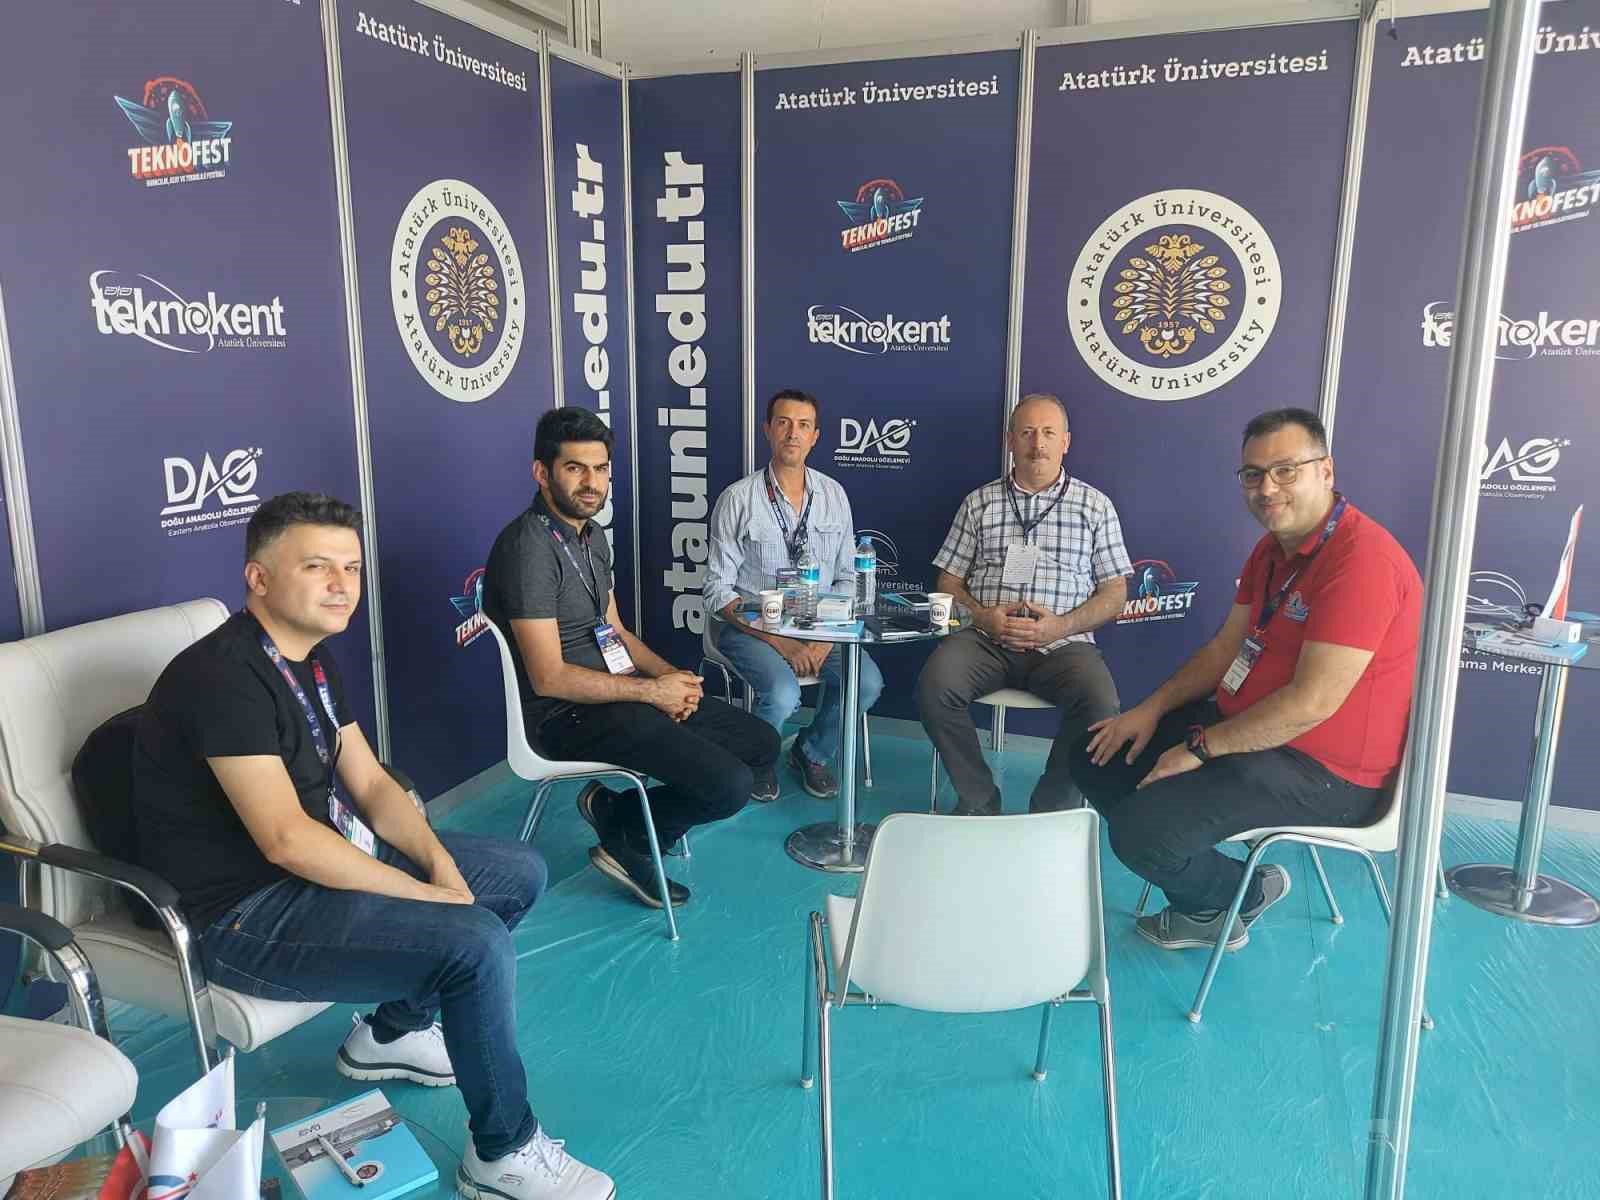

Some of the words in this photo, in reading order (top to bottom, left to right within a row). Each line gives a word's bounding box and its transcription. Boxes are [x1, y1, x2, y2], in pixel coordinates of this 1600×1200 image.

[356, 12, 430, 57] Atatürk
[432, 35, 528, 92] Üniversitesi
[1401, 38, 1485, 67] Atatü
[1535, 26, 1600, 54] Üniv
[1058, 64, 1156, 91] Atatürk
[1163, 50, 1329, 82] Üniversitesi
[775, 87, 856, 110] Atatürk
[862, 75, 999, 104] Üniversitesi
[128, 138, 232, 176] TEKNOFEST
[1511, 183, 1600, 223] KNOFEST
[399, 197, 438, 277] Atatürk
[442, 187, 519, 287] Üniversitesi
[841, 208, 922, 248] TEKNOFEST
[1081, 211, 1145, 288] Atatürk
[1154, 199, 1271, 286] Üniversitesi
[92, 286, 287, 336] teknokent
[808, 313, 951, 343] teknokent
[218, 337, 247, 348] Atatürk
[246, 336, 286, 349] Üniversitesi
[404, 313, 454, 387] Atatürk
[460, 319, 520, 391] University
[1080, 319, 1141, 385] Atatürk
[1151, 319, 1265, 391] University
[656, 151, 709, 635] atauni.edu.tr
[832, 418, 911, 455] DAG
[161, 449, 258, 514] DAG
[161, 516, 185, 528] DOĞU
[186, 510, 222, 523] ANADOLU
[222, 503, 261, 517] GÖZLEMEV
[877, 579, 923, 592] iversitesi
[1122, 592, 1196, 616] KNOFEST
[1492, 661, 1544, 676] Merkez
